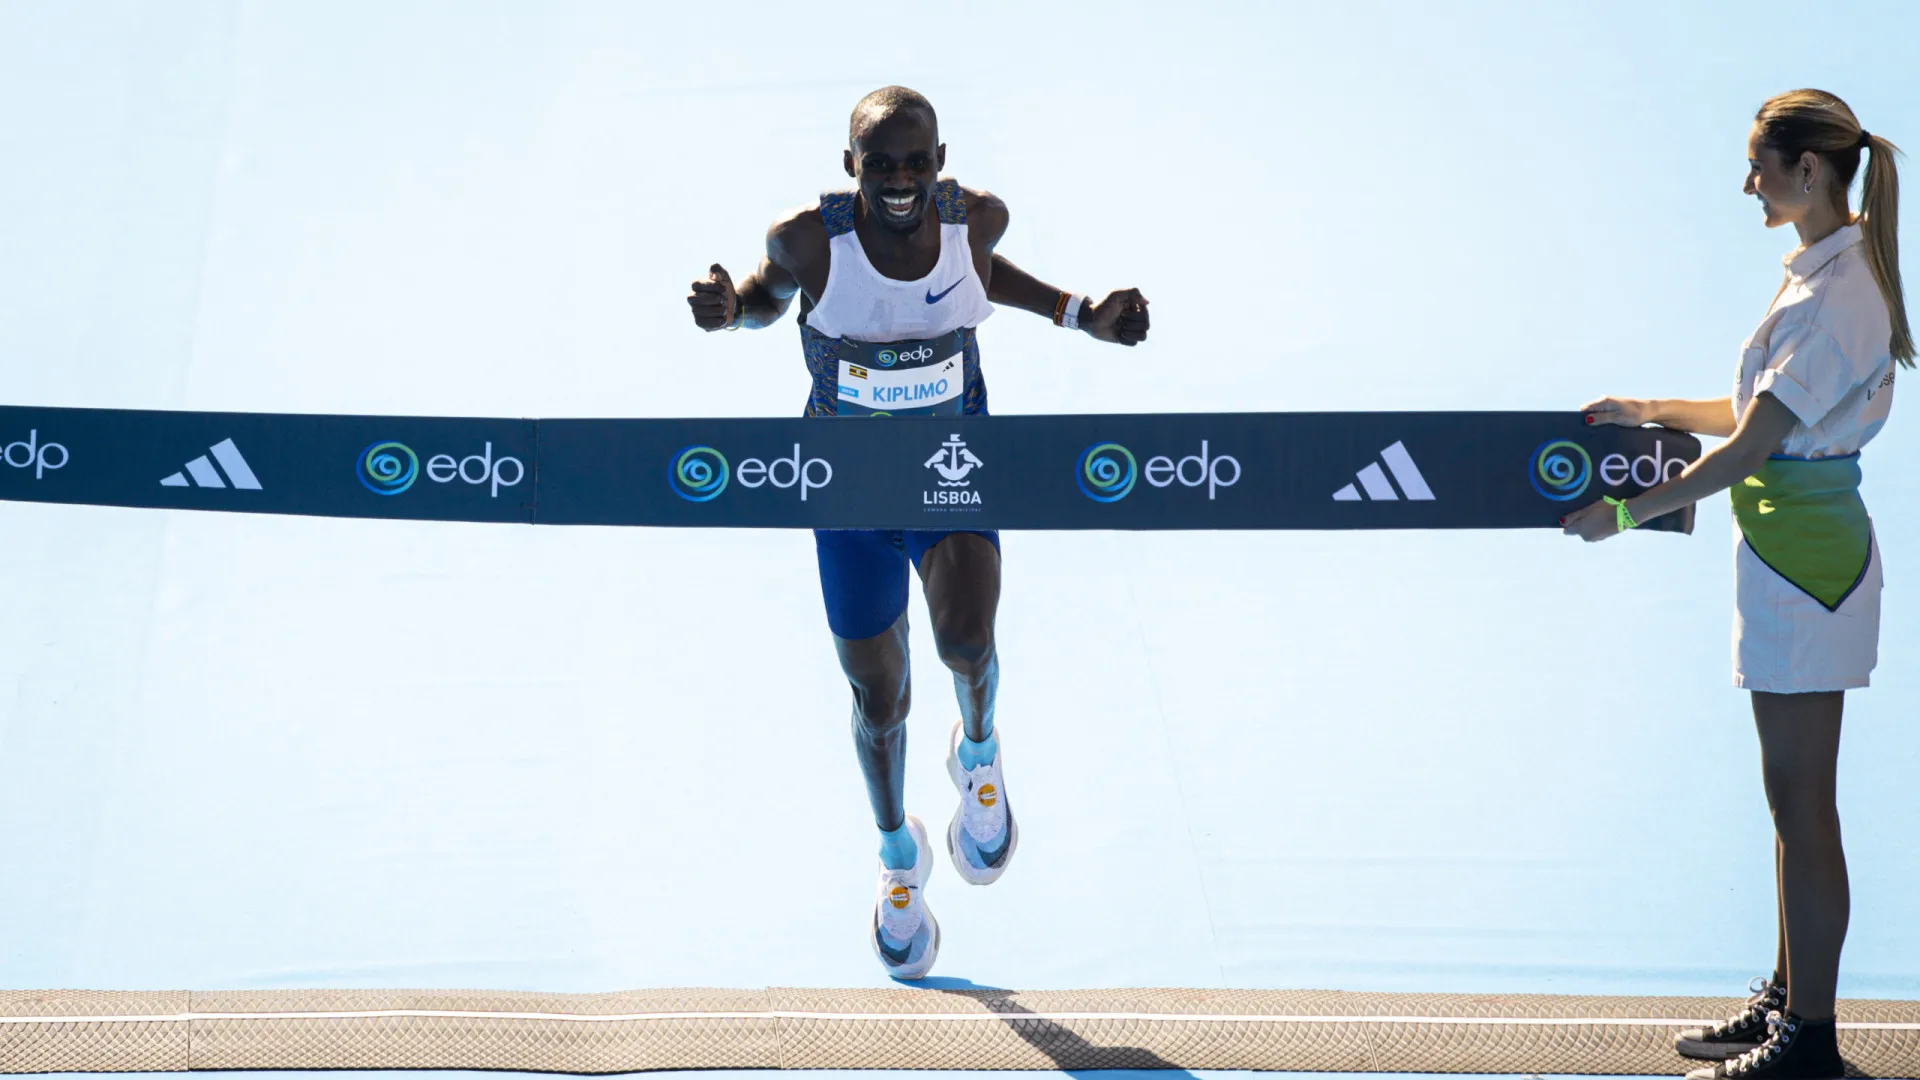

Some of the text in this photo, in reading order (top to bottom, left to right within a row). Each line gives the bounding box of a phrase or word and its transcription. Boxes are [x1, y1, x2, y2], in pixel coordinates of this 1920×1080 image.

[899, 345, 934, 363] edp
[873, 378, 948, 403] KIPLIMO
[0, 429, 69, 479] dp
[426, 441, 525, 498] edp
[736, 443, 833, 501] edp
[1144, 440, 1241, 500] edp
[923, 490, 982, 505] LISBOA
